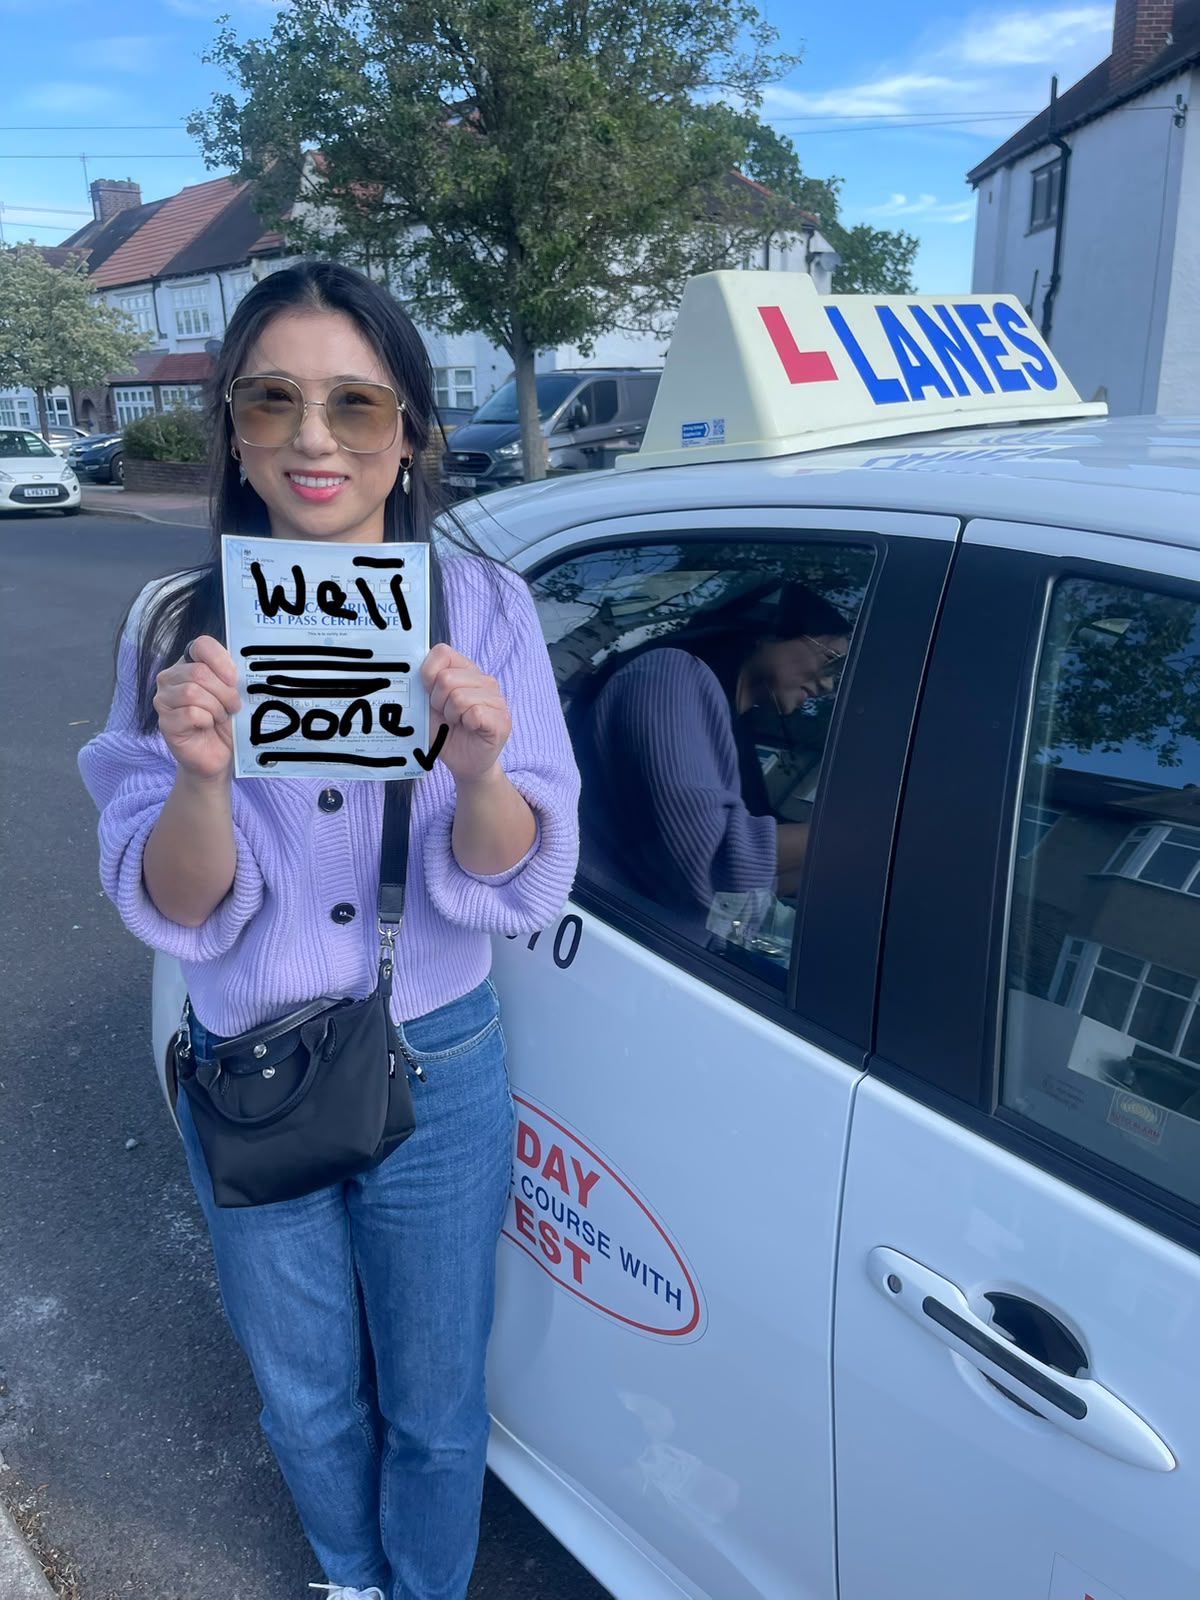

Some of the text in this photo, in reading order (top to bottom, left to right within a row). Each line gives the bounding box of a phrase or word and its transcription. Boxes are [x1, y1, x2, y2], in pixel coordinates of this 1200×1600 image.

[757, 302, 1058, 405] L LANES
[255, 613, 399, 627] TEST PASS CERFICTE
[516, 1120, 601, 1208] DAY
[509, 1193, 591, 1285] EST
[521, 1175, 682, 1312] COURSE WITH
